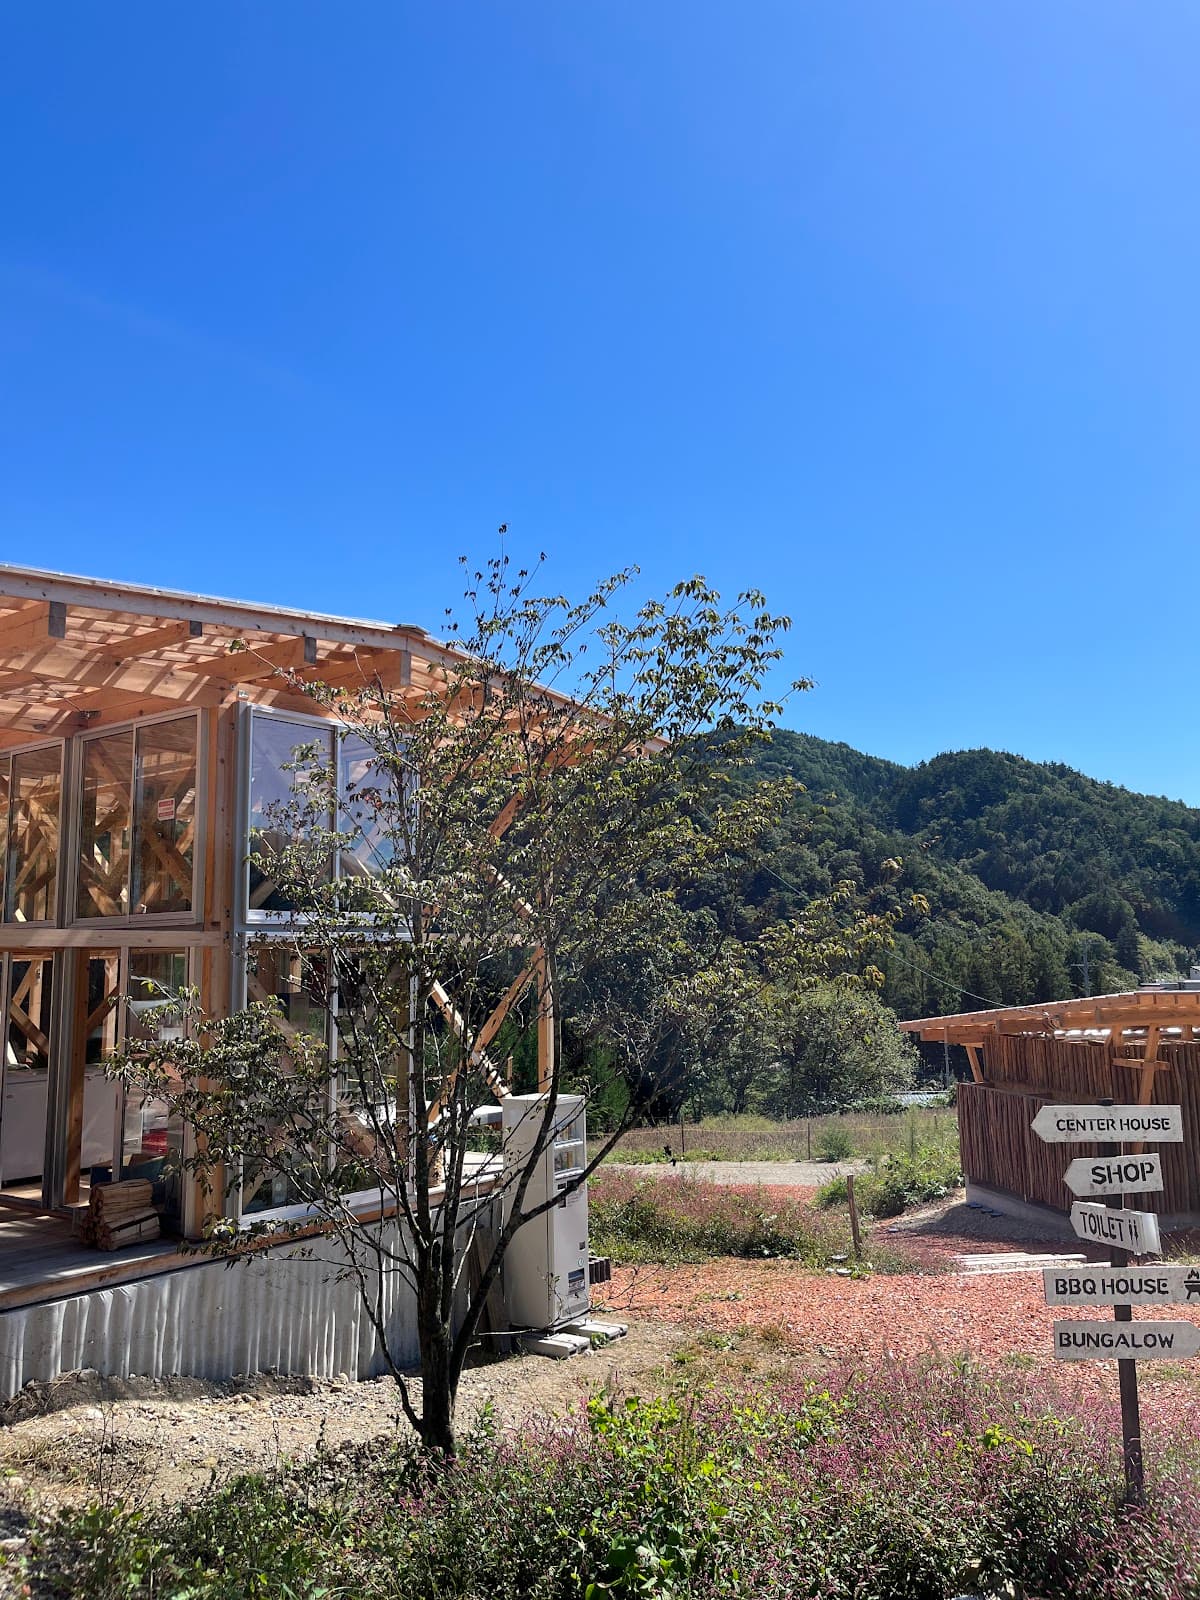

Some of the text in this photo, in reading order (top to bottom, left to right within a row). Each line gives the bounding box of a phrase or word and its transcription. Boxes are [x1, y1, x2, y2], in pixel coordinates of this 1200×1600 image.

[1056, 1117, 1171, 1131] CENTER HOUSE
[1091, 1162, 1155, 1185] SHOP
[1079, 1211, 1124, 1242] TOILET
[1055, 1278, 1169, 1295] BBQ HOUSE
[1059, 1332, 1174, 1349] BUNGALOW
